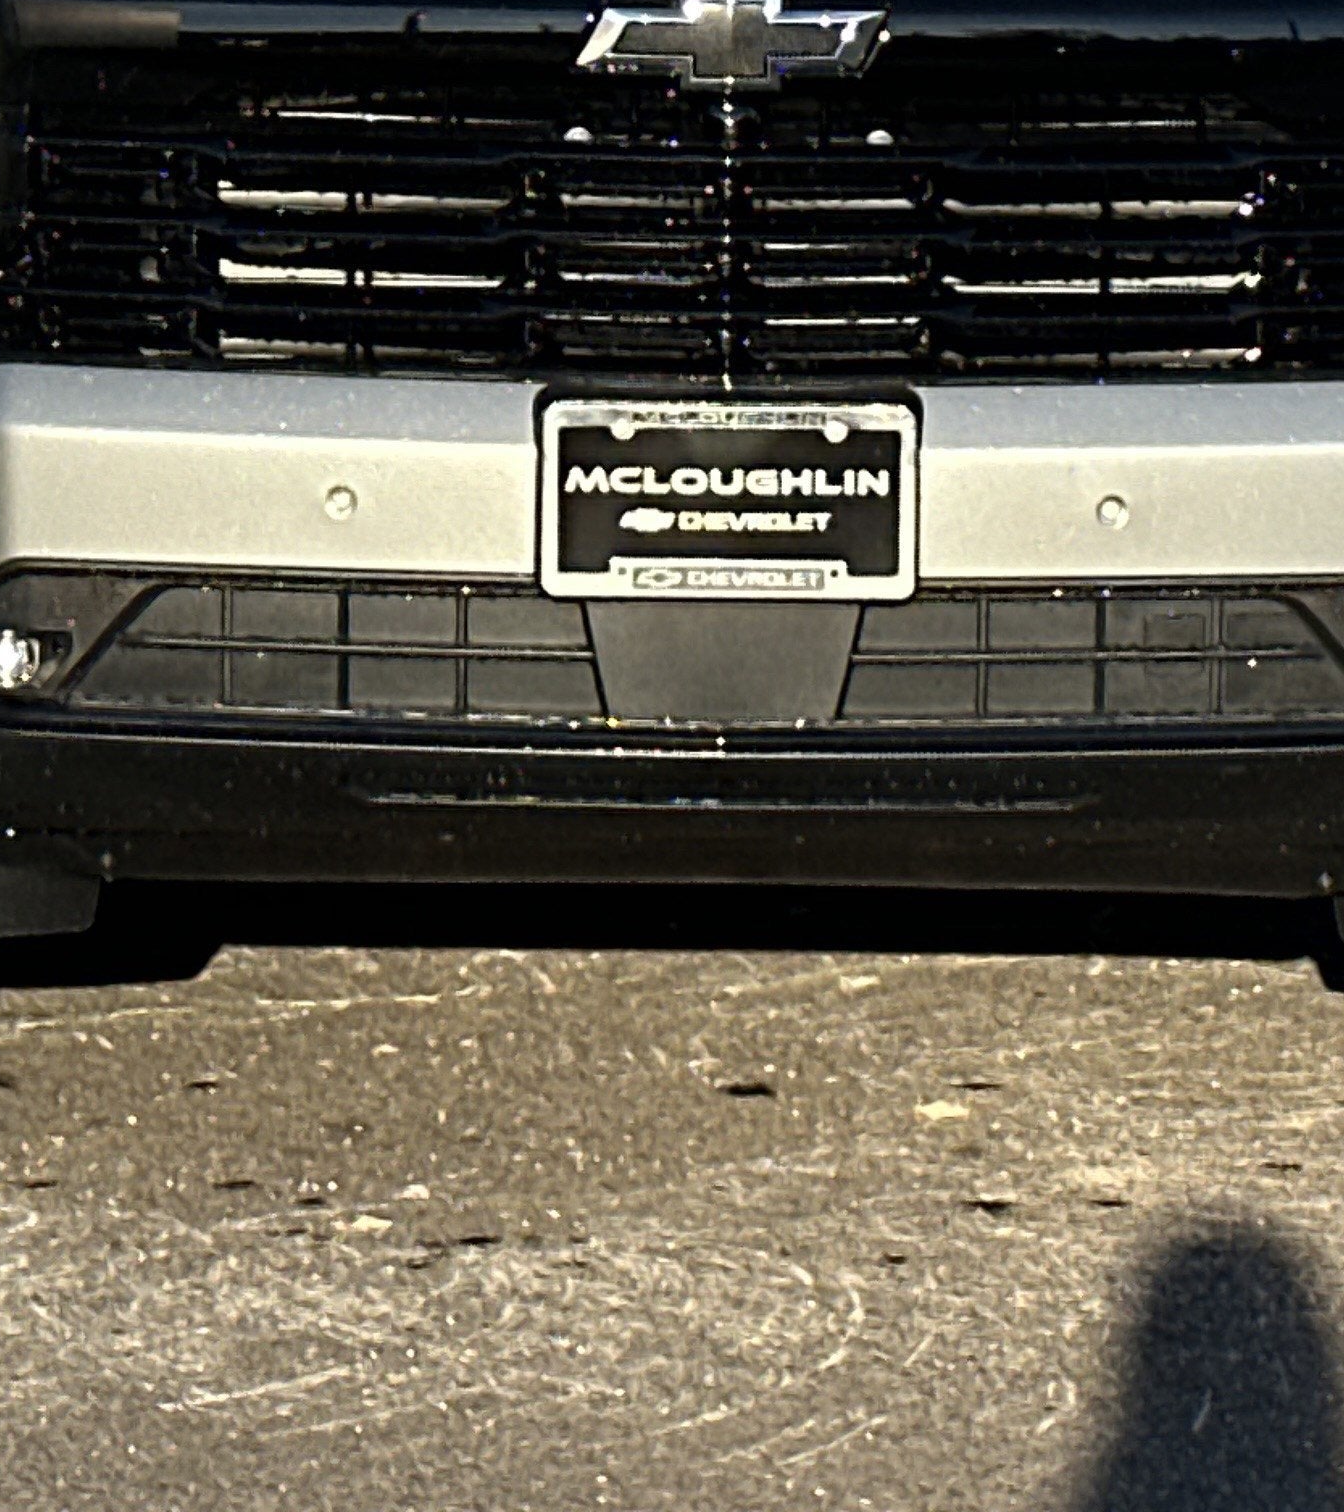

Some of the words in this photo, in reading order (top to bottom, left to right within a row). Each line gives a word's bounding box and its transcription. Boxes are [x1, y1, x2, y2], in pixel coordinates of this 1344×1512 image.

[564, 465, 890, 497] MCLOUGHLIN
[677, 510, 833, 532] CHEVROLET
[686, 569, 821, 588] CHEVROLET
